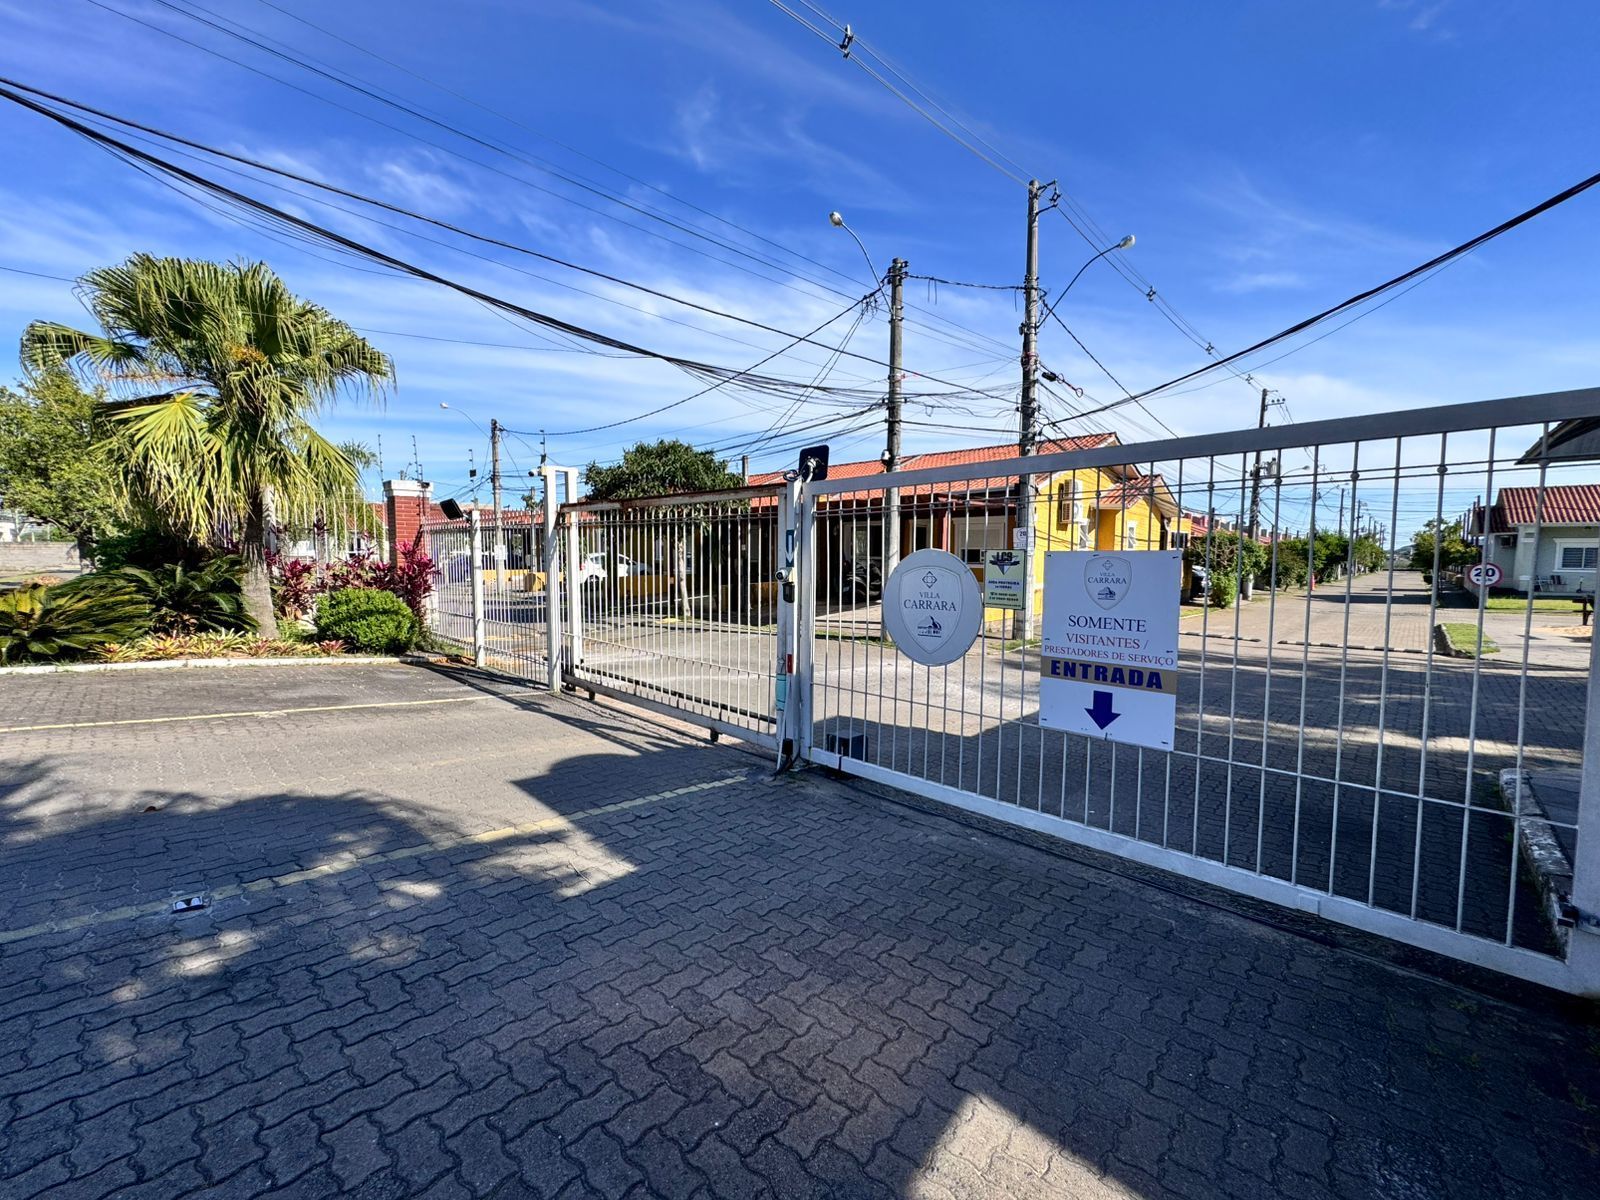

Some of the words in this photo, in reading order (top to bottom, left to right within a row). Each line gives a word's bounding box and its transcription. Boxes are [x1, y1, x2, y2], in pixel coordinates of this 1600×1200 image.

[1474, 567, 1496, 577] 20
[1087, 576, 1127, 585] CARRARA
[919, 591, 940, 599] VILLA
[903, 599, 957, 611] CARRARA
[1068, 614, 1147, 632] SOMENTE
[1066, 633, 1140, 649] VISITANTES
[1044, 644, 1109, 659] PRESTADORES
[1111, 652, 1125, 661] DE
[1128, 653, 1174, 666] SERVIÇO
[1051, 659, 1163, 690] ENTRADA
